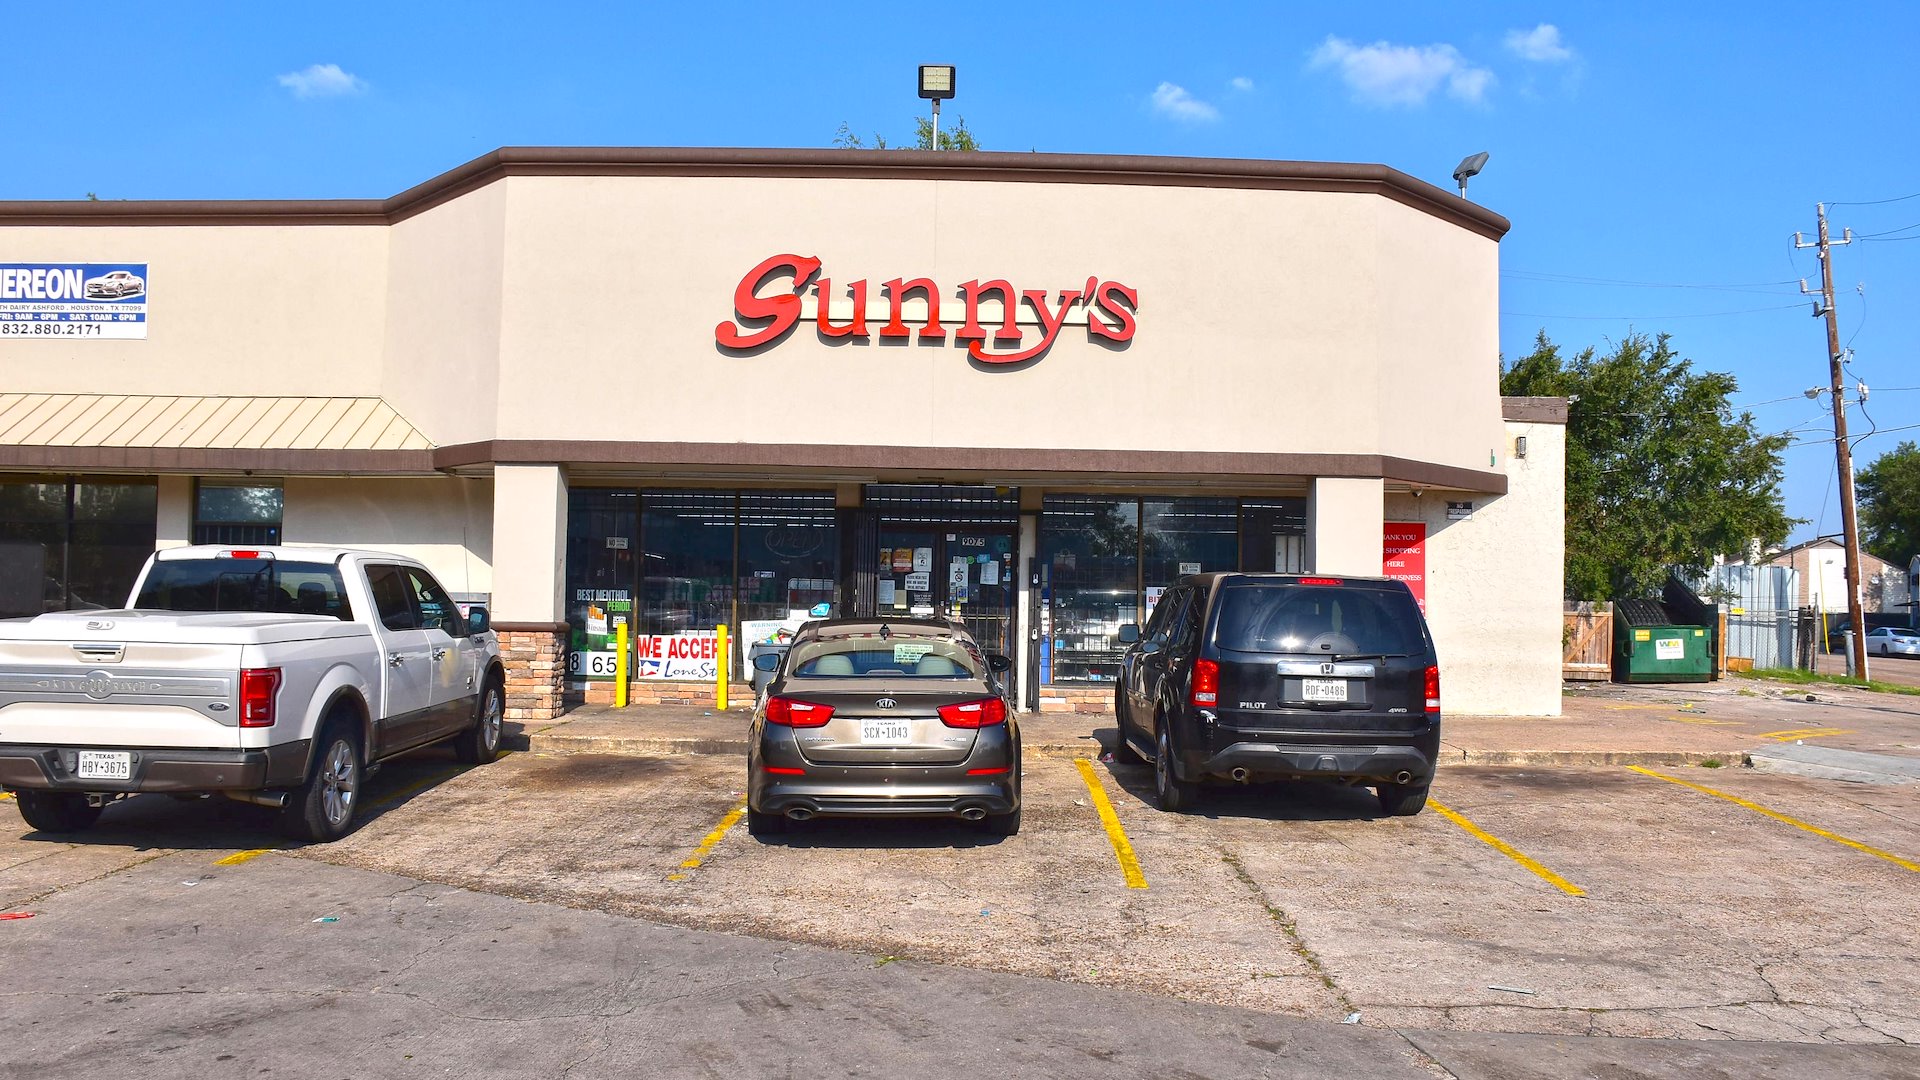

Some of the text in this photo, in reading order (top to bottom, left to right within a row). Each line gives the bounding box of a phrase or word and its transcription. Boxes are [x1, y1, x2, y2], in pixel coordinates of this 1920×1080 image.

[0, 268, 83, 299] EREON
[714, 253, 1139, 363] Sunny's
[14, 313, 34, 321] 9AM
[40, 313, 59, 321] 6PM
[69, 313, 88, 321] SAT:
[89, 313, 113, 321] 10AM
[118, 313, 137, 321] 6PM
[2, 323, 102, 336] 832.880.2171
[962, 537, 985, 547] 9075
[1385, 547, 1421, 555] SHOPPING
[1386, 560, 1405, 568] HERE
[577, 588, 595, 601] BEST
[607, 601, 632, 612] PERIOD.
[638, 637, 662, 658] WE
[571, 653, 579, 670] 8
[664, 660, 699, 678] Lone
[53, 679, 146, 692] KING RANCH
[1239, 701, 1266, 709] PILOT
